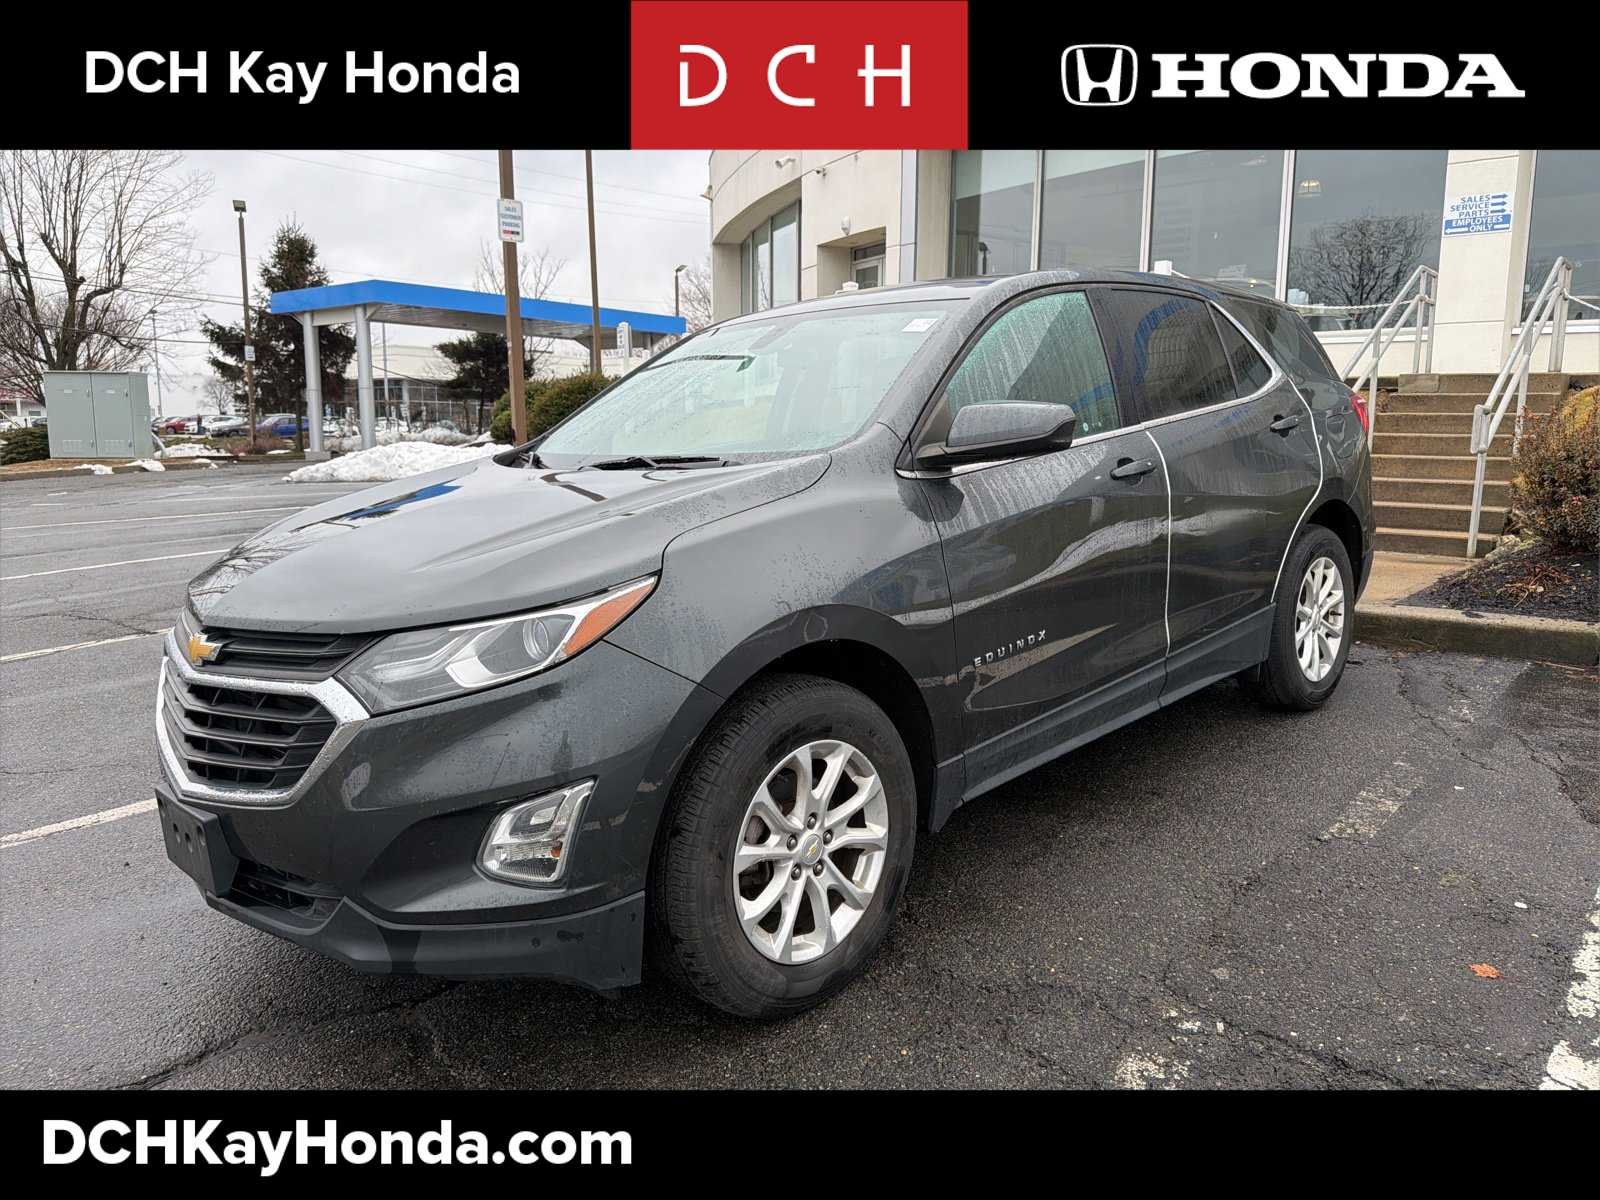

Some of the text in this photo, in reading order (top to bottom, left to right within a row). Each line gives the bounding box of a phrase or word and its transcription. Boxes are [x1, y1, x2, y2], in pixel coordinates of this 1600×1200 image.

[1461, 194, 1490, 204] SALES
[1450, 201, 1490, 212] SERVICE
[1459, 209, 1489, 218] PARTS
[1452, 215, 1503, 227] EMPLOYEES
[1469, 224, 1493, 232] ONLY
[974, 629, 1046, 667] EQUINOX
